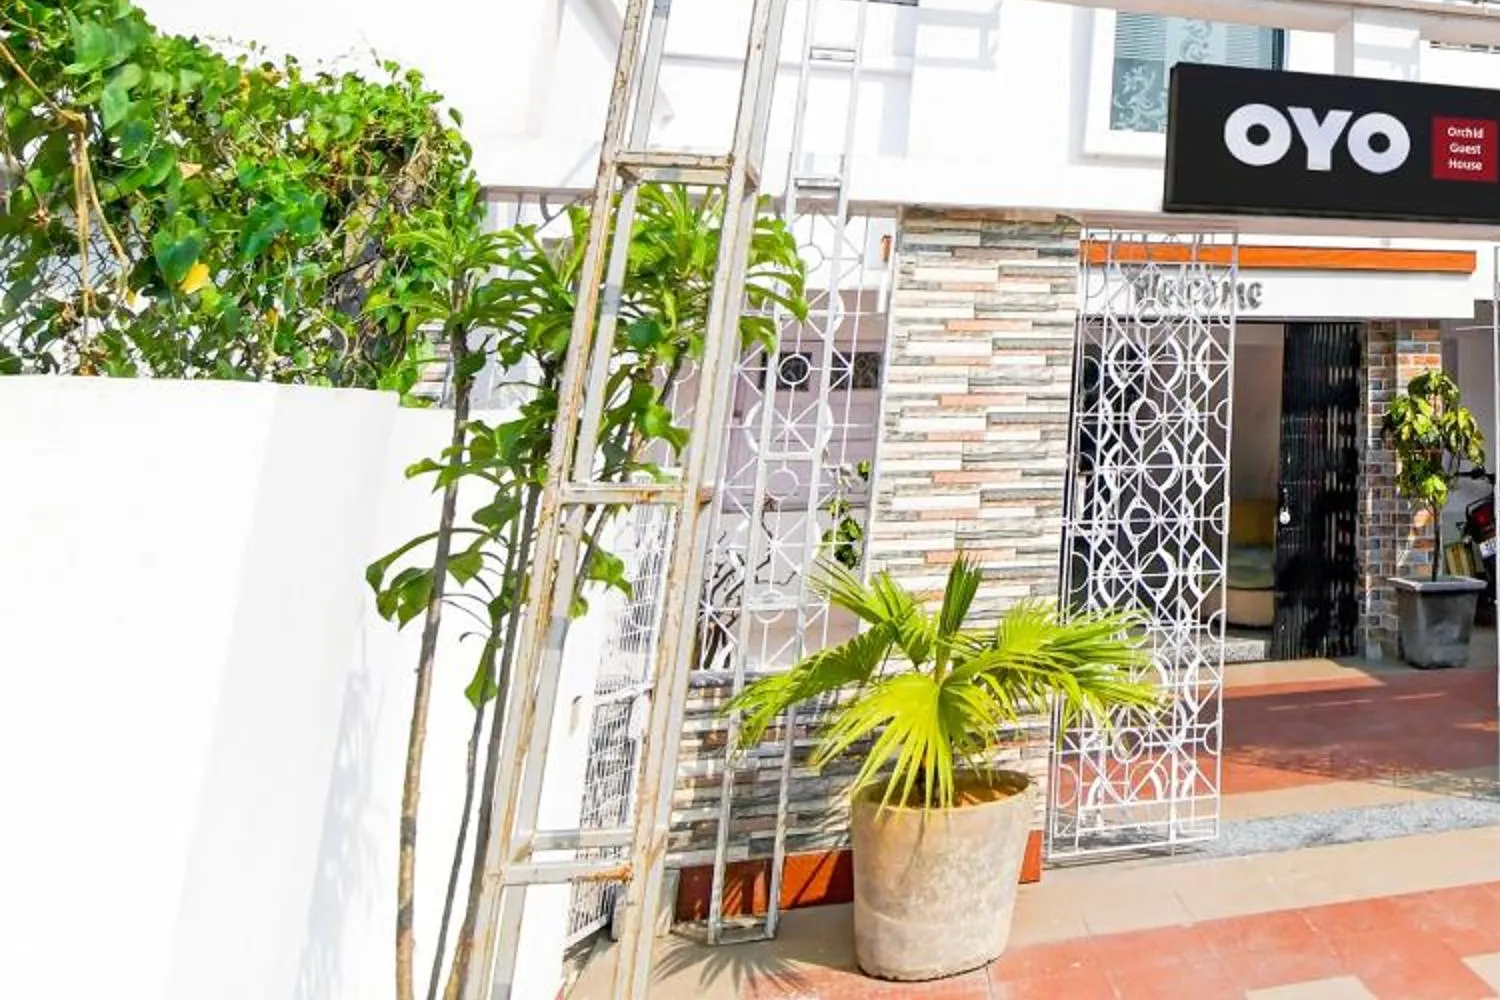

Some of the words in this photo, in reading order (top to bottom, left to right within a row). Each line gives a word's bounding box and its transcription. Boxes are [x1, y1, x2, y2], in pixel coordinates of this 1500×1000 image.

[1224, 103, 1411, 174] OYO
[1447, 126, 1484, 139] Orchid
[1449, 142, 1482, 155] Guest
[1447, 158, 1483, 171] House
